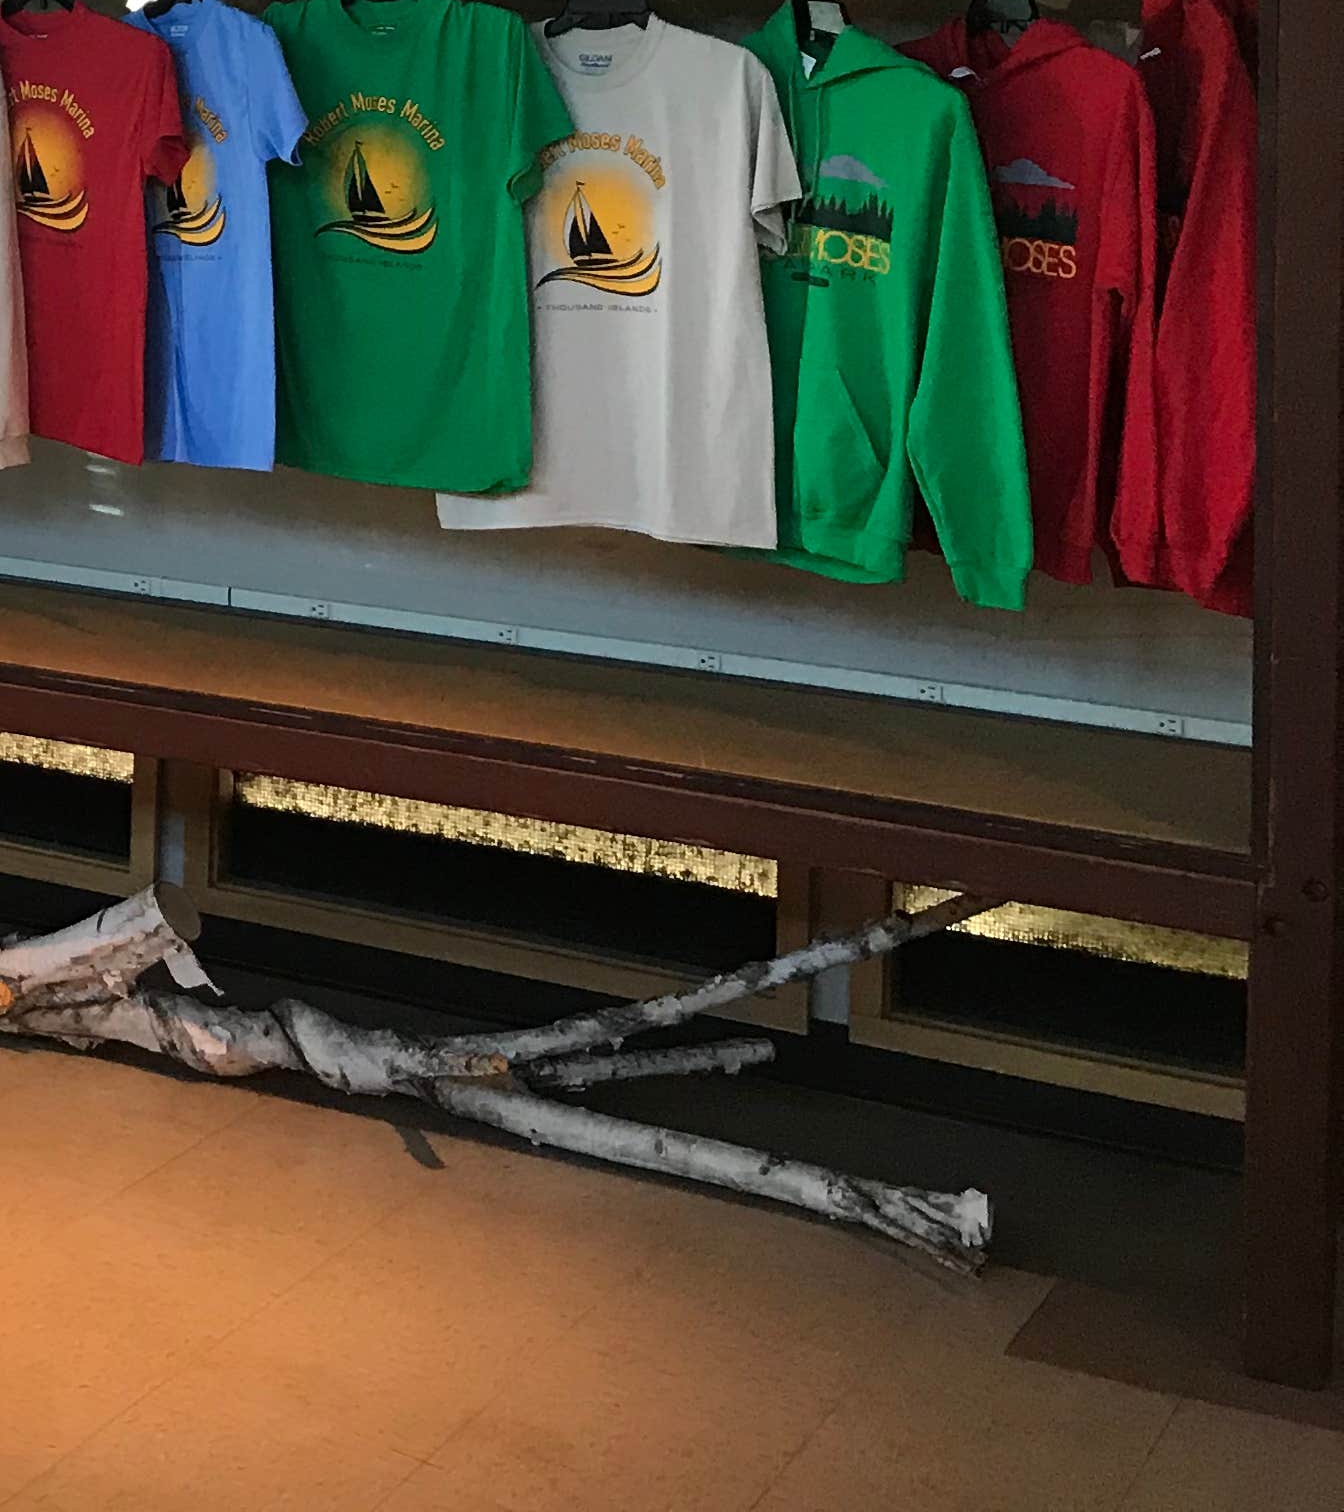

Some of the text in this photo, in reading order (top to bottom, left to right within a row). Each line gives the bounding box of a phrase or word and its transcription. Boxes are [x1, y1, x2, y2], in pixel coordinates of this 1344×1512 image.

[19, 80, 95, 140] Moses Marina
[195, 96, 229, 144] Marina
[304, 92, 446, 151] Robert Moses Marina
[566, 131, 621, 152] Moses
[623, 134, 666, 189] Marina
[1005, 237, 1077, 279] OSES
[545, 303, 604, 313] THOUSAND
